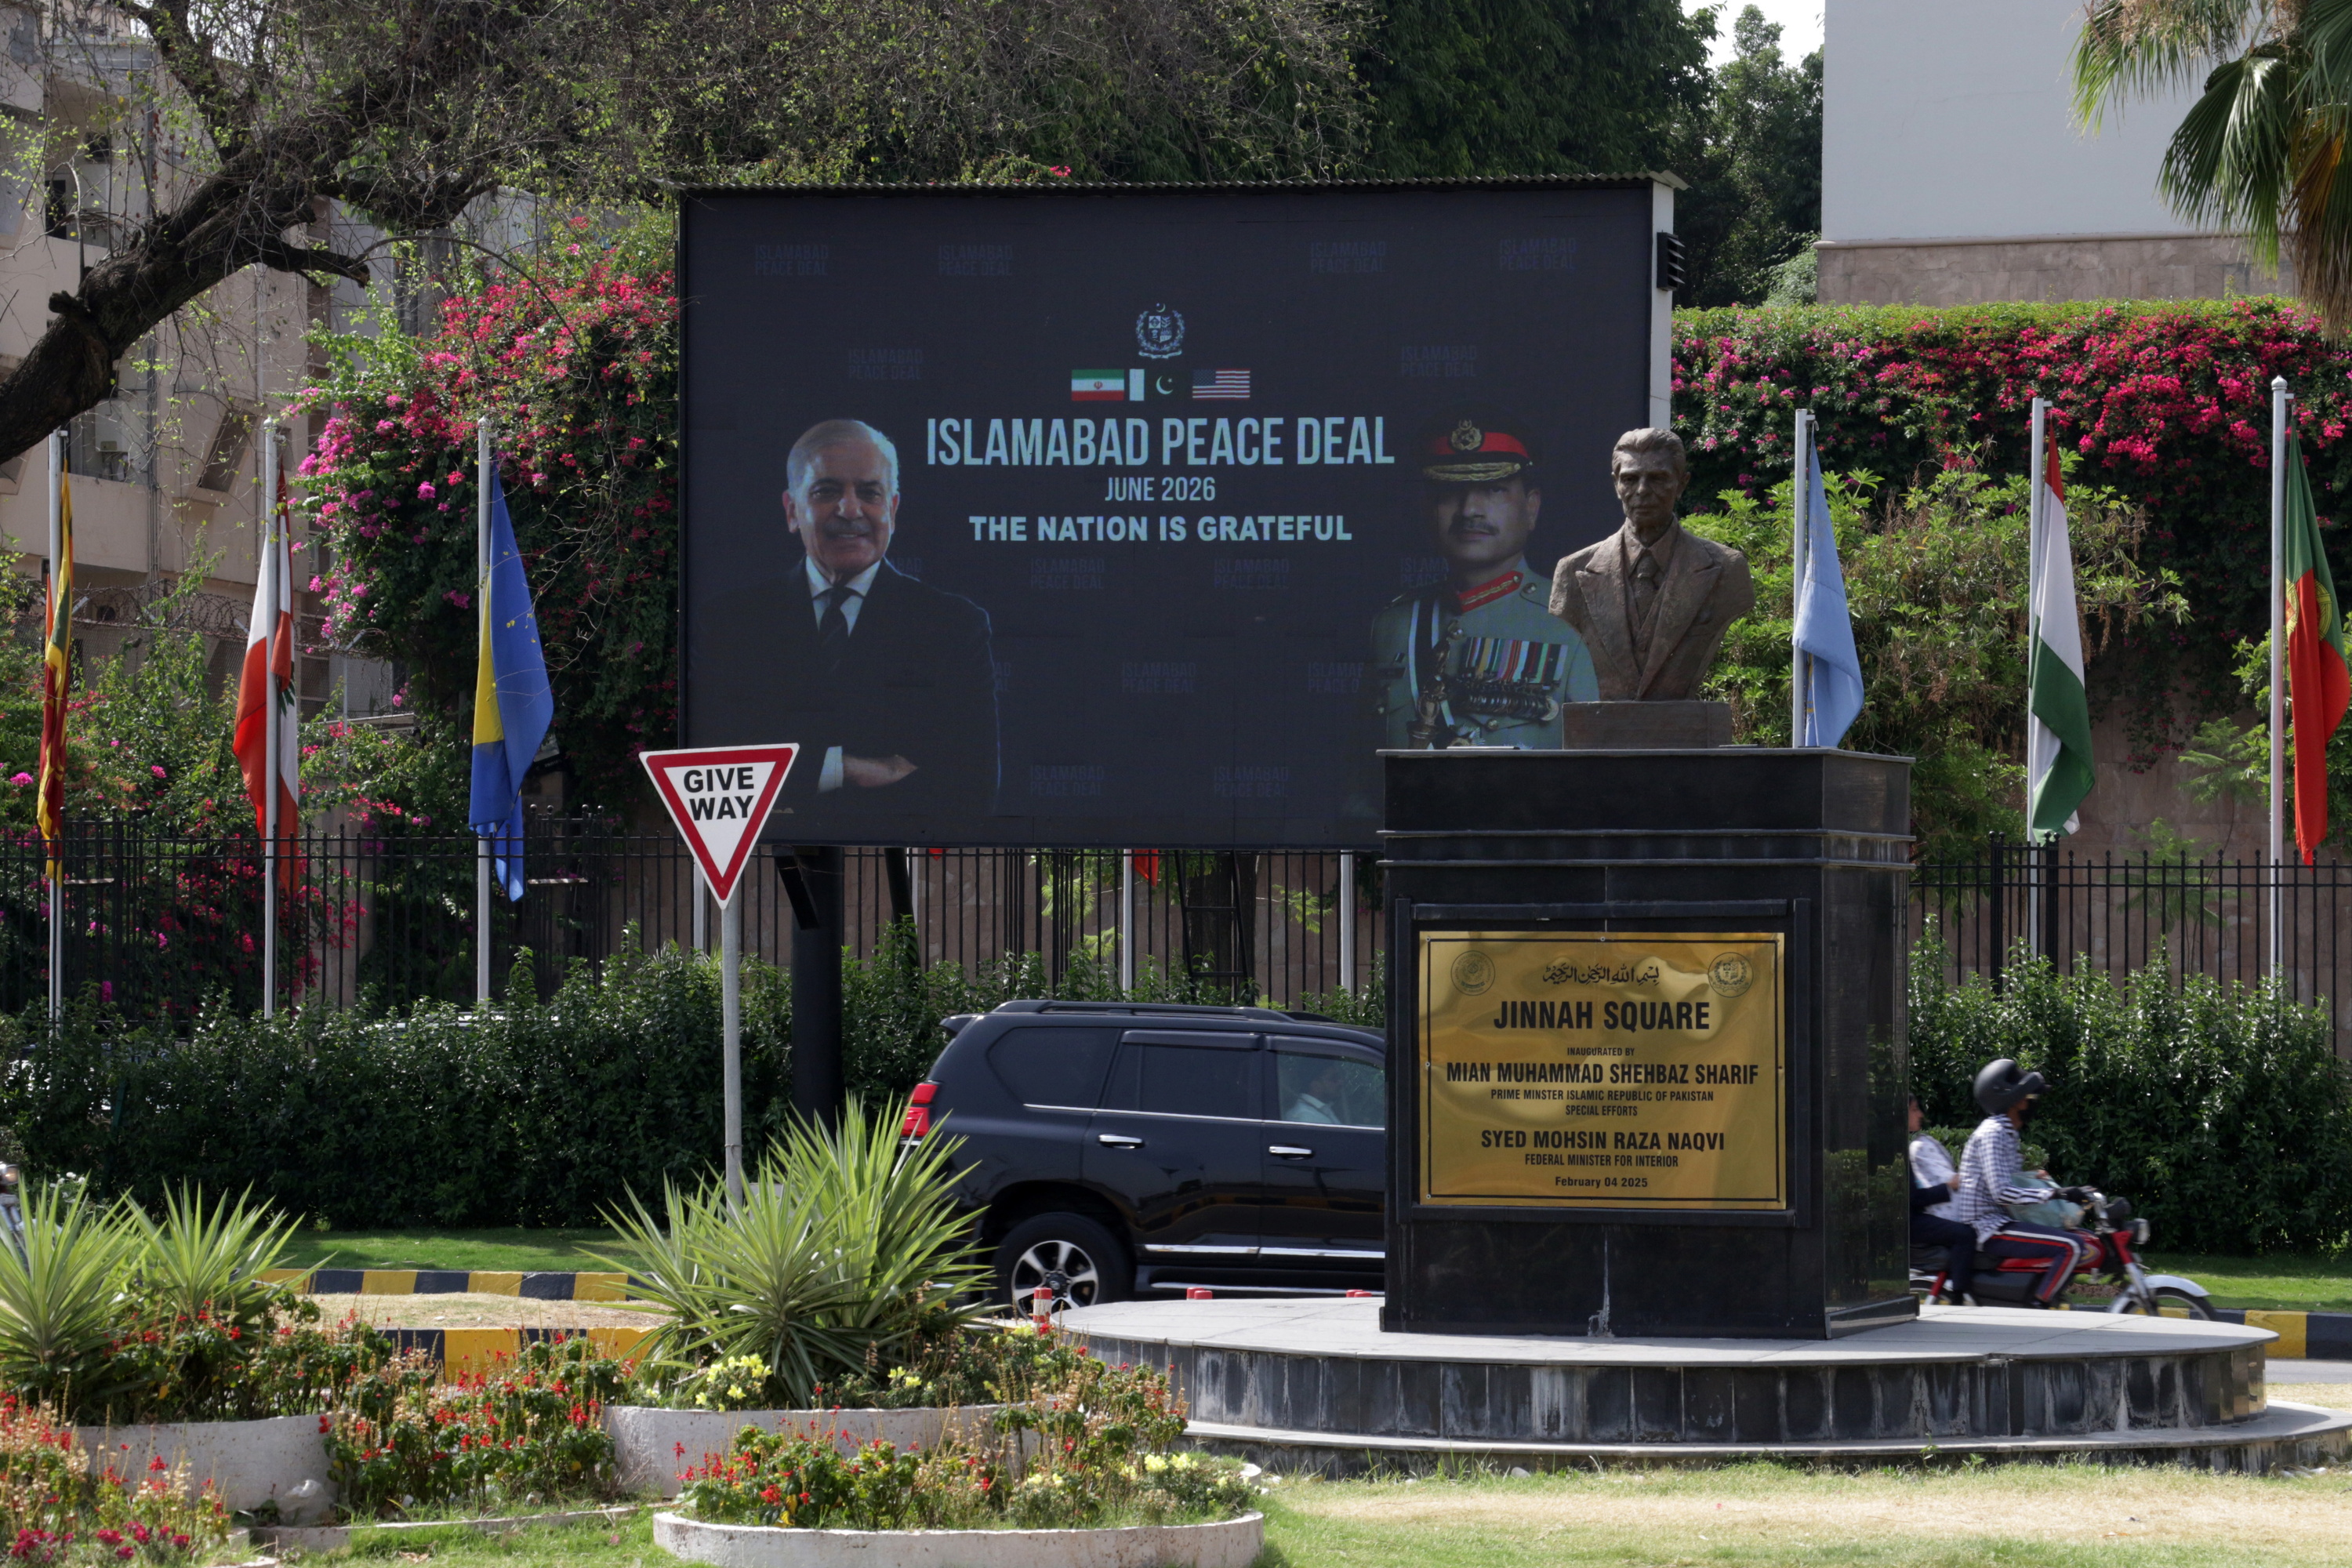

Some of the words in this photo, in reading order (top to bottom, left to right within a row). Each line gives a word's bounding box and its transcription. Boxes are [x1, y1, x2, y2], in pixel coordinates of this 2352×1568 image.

[754, 244, 829, 260] ISLAMABAD
[938, 244, 1013, 260] ISLAMABAD
[1310, 241, 1386, 257] ISLAMABAD
[1499, 238, 1577, 254] ISLAMABAD
[848, 348, 923, 364] ISLAMABAD
[1401, 346, 1477, 361] ISLAMABAD
[927, 418, 1149, 466] ISLAMABAD
[1162, 417, 1284, 466] PEACE
[1297, 416, 1395, 465] DEAL
[1105, 477, 1155, 502] JUNE
[1161, 476, 1216, 502] 2026
[968, 516, 1027, 541] THE
[1037, 516, 1148, 541] NATION
[1160, 516, 1187, 541] IS
[1197, 515, 1352, 541] GRATEFUL
[1030, 557, 1105, 573] ISLAMABAD
[1214, 557, 1290, 573] ISLAMABAD
[1400, 557, 1450, 573] ISLAMA
[1122, 662, 1196, 677] ISLAMABAD
[684, 766, 754, 793] GIVE
[1029, 765, 1105, 781] ISLAMABAD
[1214, 766, 1290, 782] ISLAMABAD
[689, 795, 754, 821] WAY
[1494, 1000, 1593, 1029] JINNAH
[1603, 1000, 1710, 1033] SQUARE
[1566, 1047, 1623, 1056] INAUGURATED
[1624, 1047, 1635, 1056] BY
[1446, 1062, 1490, 1082] MIAN
[1497, 1062, 1603, 1083] MUHAMMAD
[1610, 1063, 1689, 1084] SHEHBAZ
[1695, 1064, 1759, 1085] SHARIF
[1490, 1089, 1520, 1100] PRIME
[1523, 1089, 1564, 1100] MINSTER
[1566, 1090, 1604, 1101] ISLAMIC
[1607, 1091, 1652, 1102] REPUBLIC
[1656, 1091, 1668, 1102] OF
[1670, 1091, 1714, 1102] PAKISTAN
[1565, 1105, 1599, 1116] SPECIAL
[1602, 1105, 1638, 1116] EFFORTS
[1481, 1130, 1526, 1148] SYED
[1534, 1131, 1606, 1149] MOHSIN
[1614, 1131, 1661, 1150] RAZA
[1668, 1132, 1724, 1152] NAQVI
[1525, 1153, 1565, 1166] FEDERAL
[1567, 1154, 1611, 1166] MINISTER
[1614, 1155, 1632, 1167] FOR
[1635, 1155, 1679, 1167] INTERIOR
[1555, 1176, 1601, 1189] February
[1604, 1177, 1617, 1187] 04
[1621, 1178, 1648, 1188] 2025
